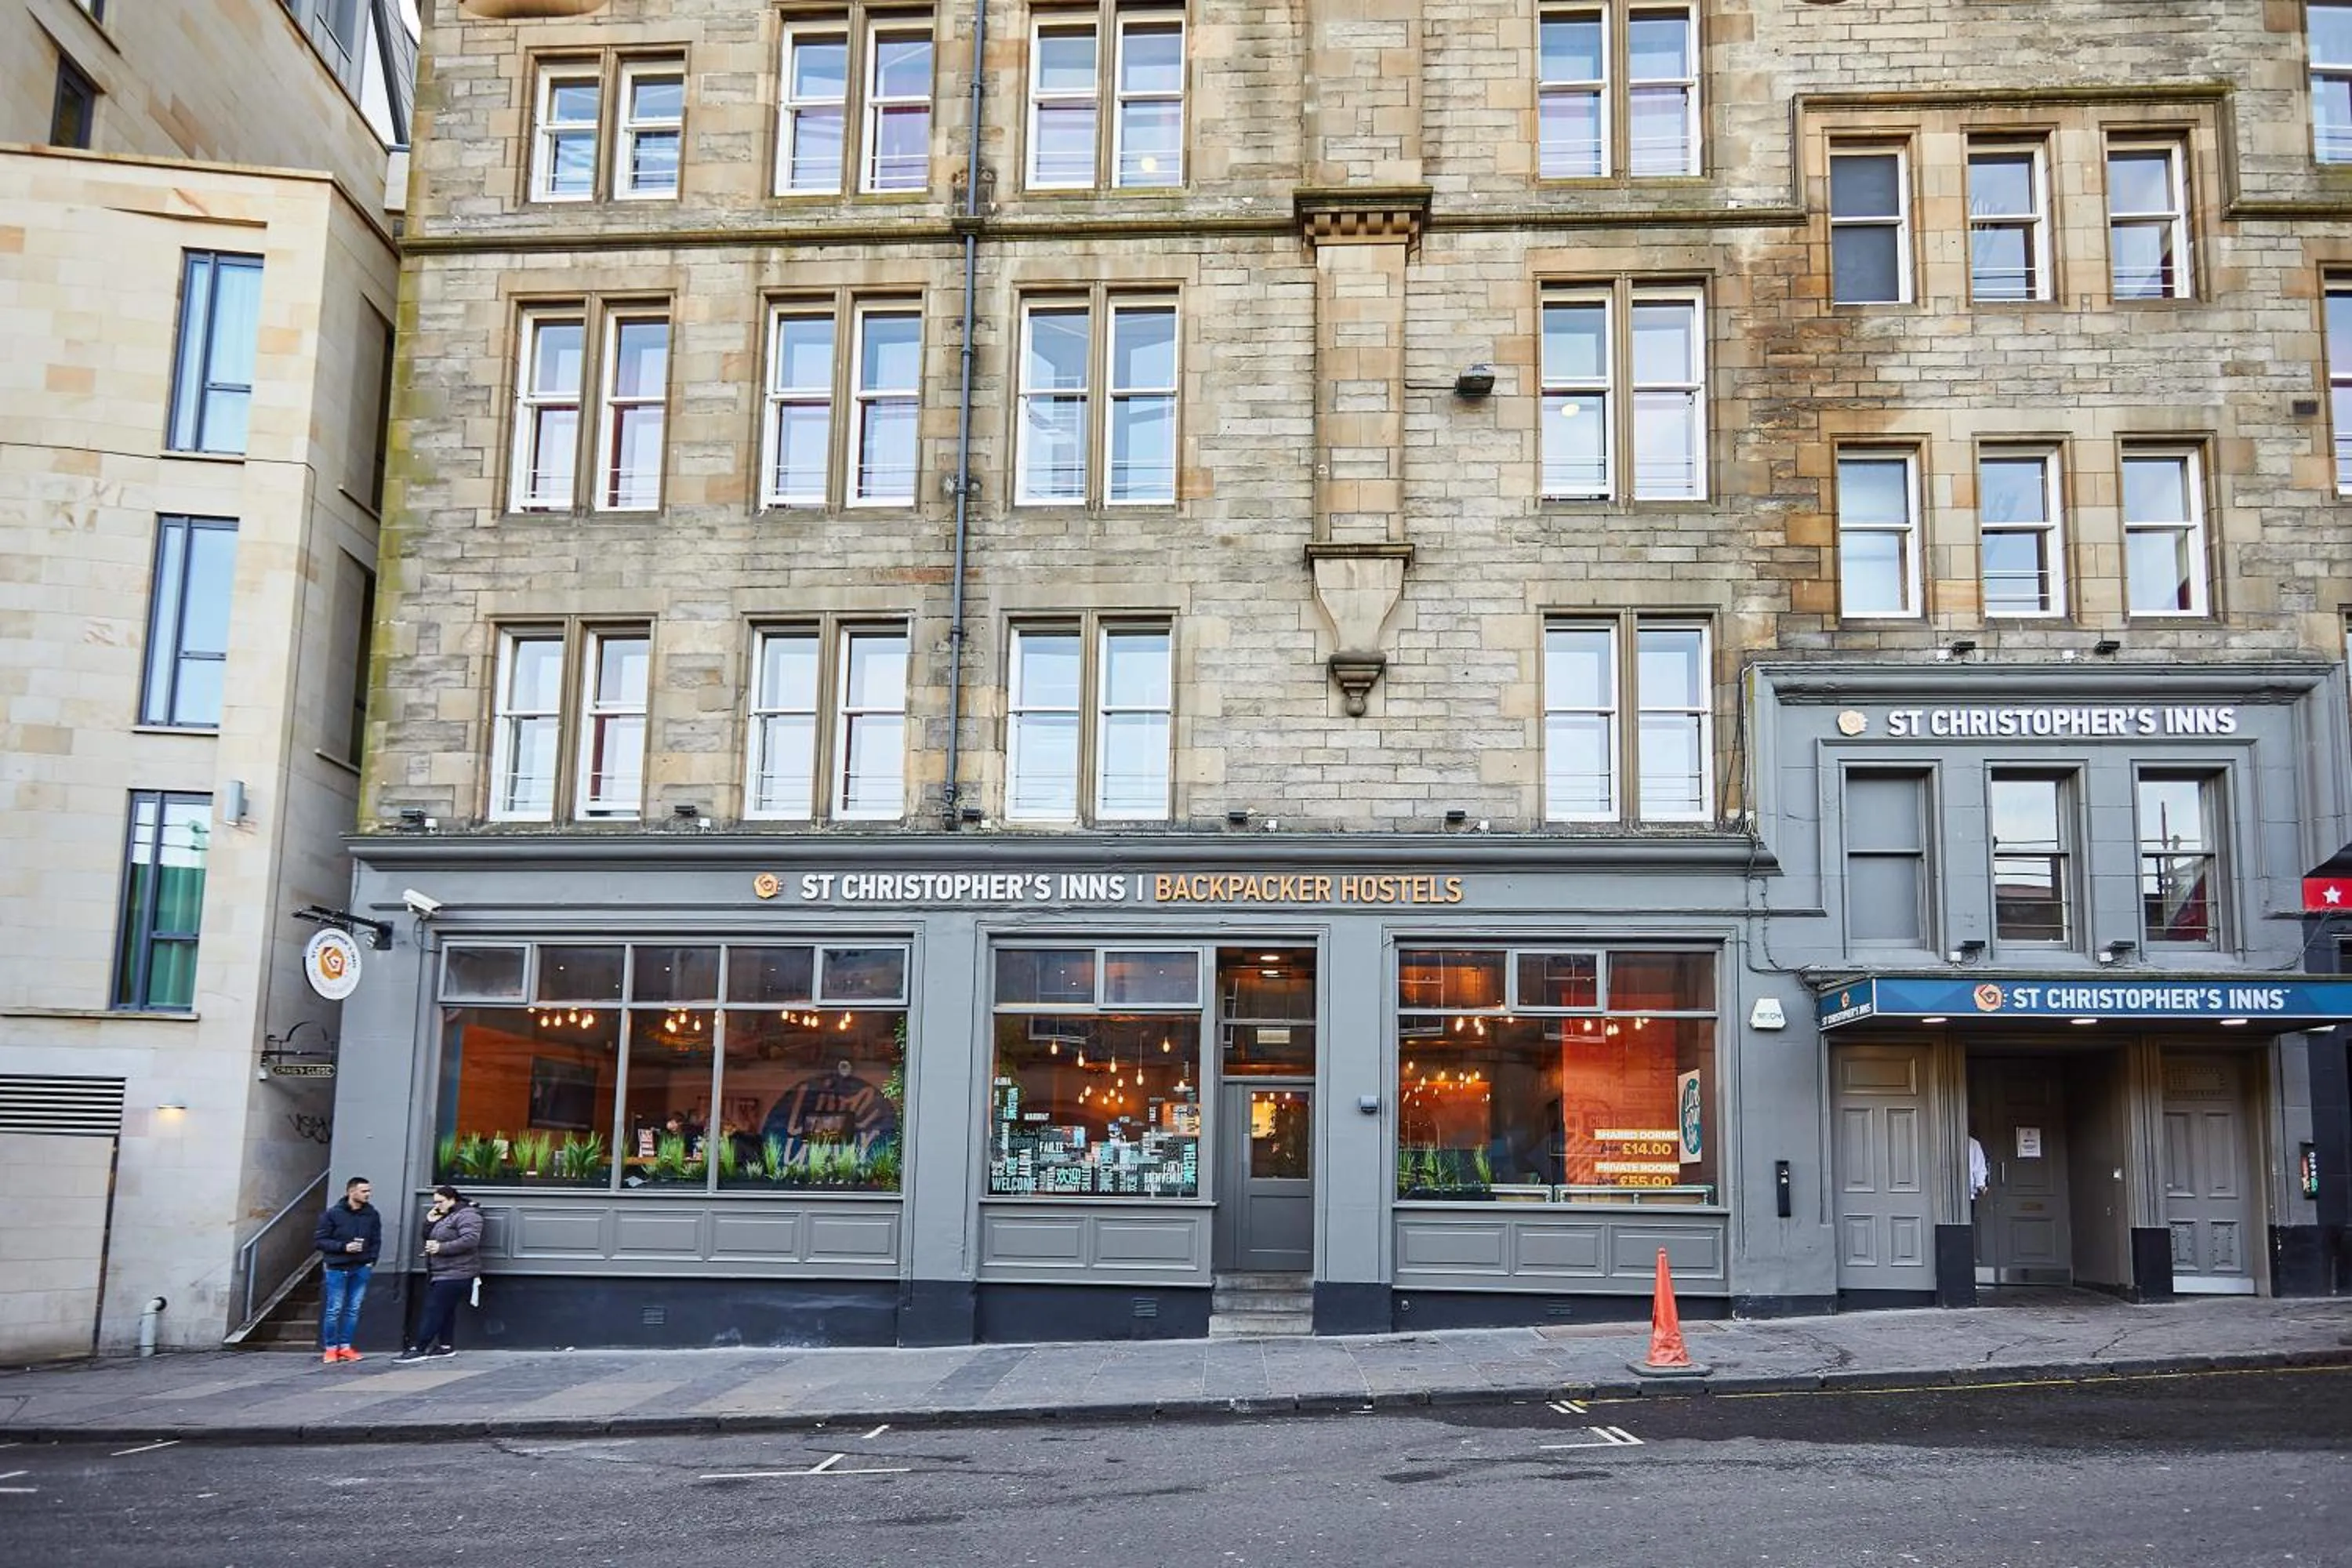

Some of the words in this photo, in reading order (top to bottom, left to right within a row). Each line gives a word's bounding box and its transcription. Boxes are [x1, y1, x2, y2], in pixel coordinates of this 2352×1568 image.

[1888, 710, 1922, 736] ST
[1930, 708, 2158, 735] CHRISTOPHER'S
[2164, 707, 2237, 734] INNS
[801, 874, 835, 899] ST
[841, 874, 1051, 900] CHRISTOPHER'S
[1060, 874, 1126, 900] INNS
[1154, 874, 1332, 902] BACKPACKER
[1341, 875, 1463, 903] HOSTELS
[2013, 988, 2041, 1009] ST
[2047, 988, 2223, 1010] CHRISTOPHER'S
[2229, 989, 2284, 1011] INNS
[1639, 1130, 1679, 1139] DORMS
[1622, 1142, 1672, 1155] £14.00
[1184, 1143, 1196, 1184] WELCOME
[991, 1177, 1038, 1191] WELCOME
[1055, 1167, 1081, 1185] 欢迎
[1619, 1175, 1672, 1185] £55.00
